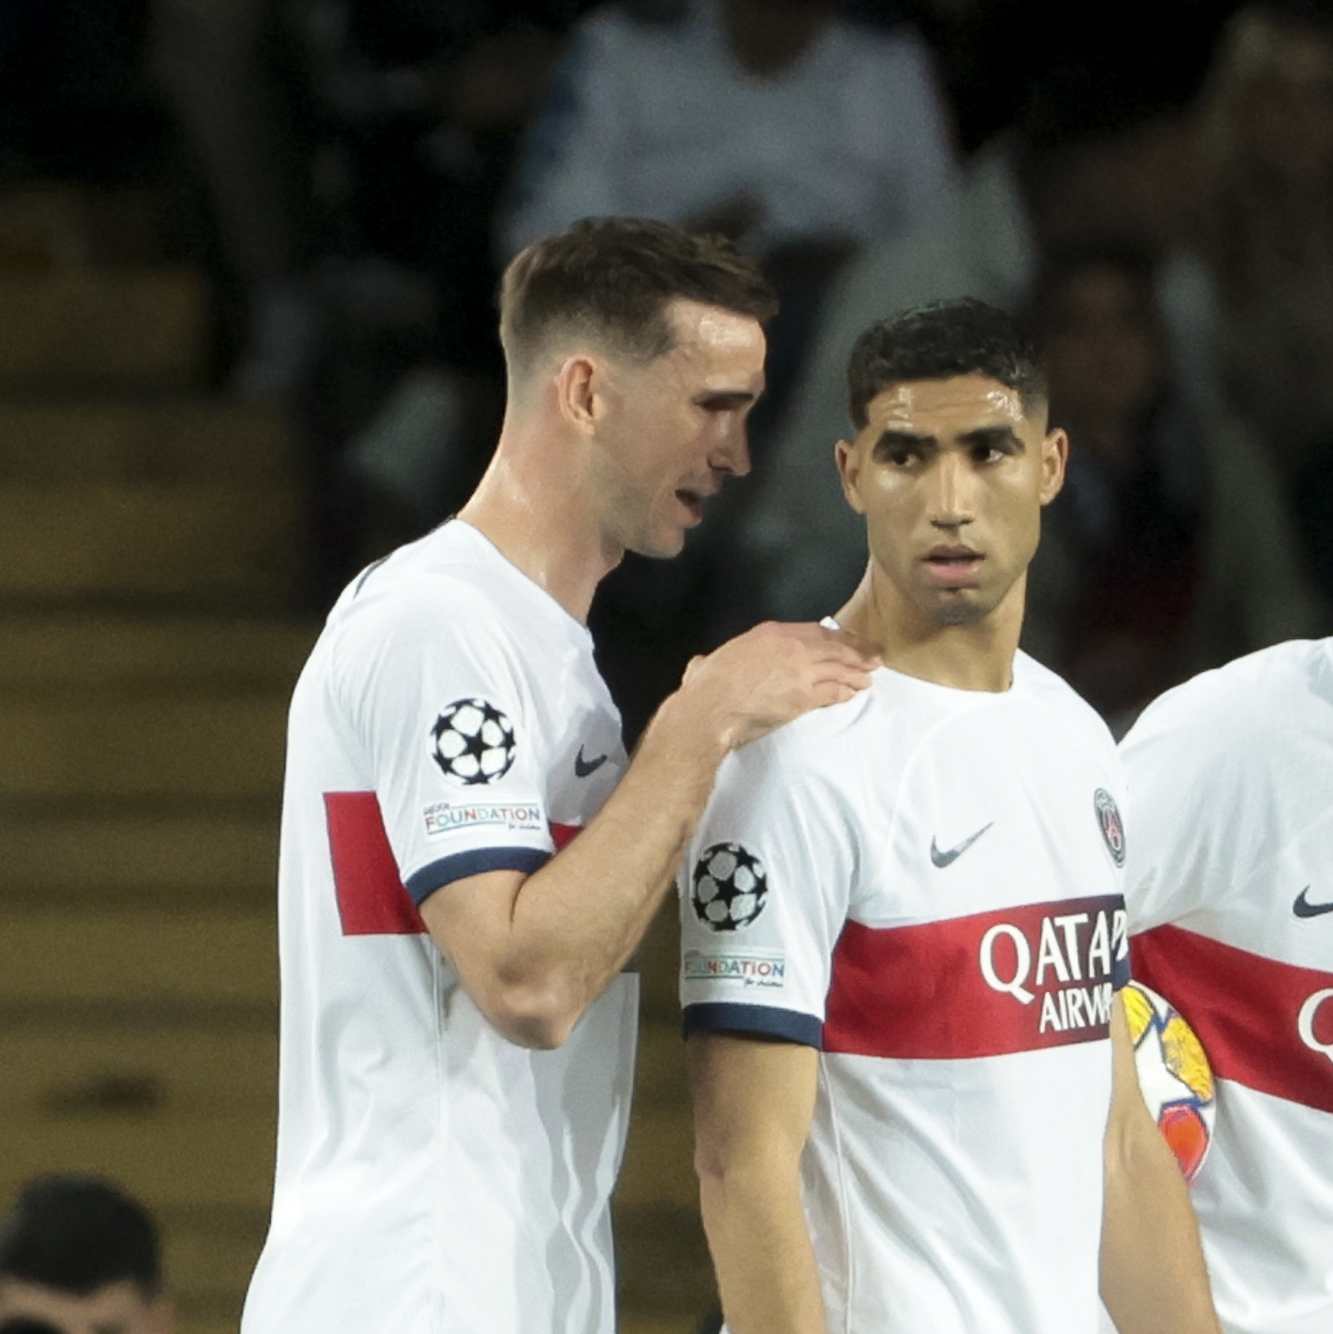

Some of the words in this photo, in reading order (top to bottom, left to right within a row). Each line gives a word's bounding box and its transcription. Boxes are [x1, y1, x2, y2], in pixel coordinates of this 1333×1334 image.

[425, 808, 540, 831] FOUNDATION
[979, 909, 1129, 1005] QATAR
[1039, 982, 1113, 1034] AIRW
